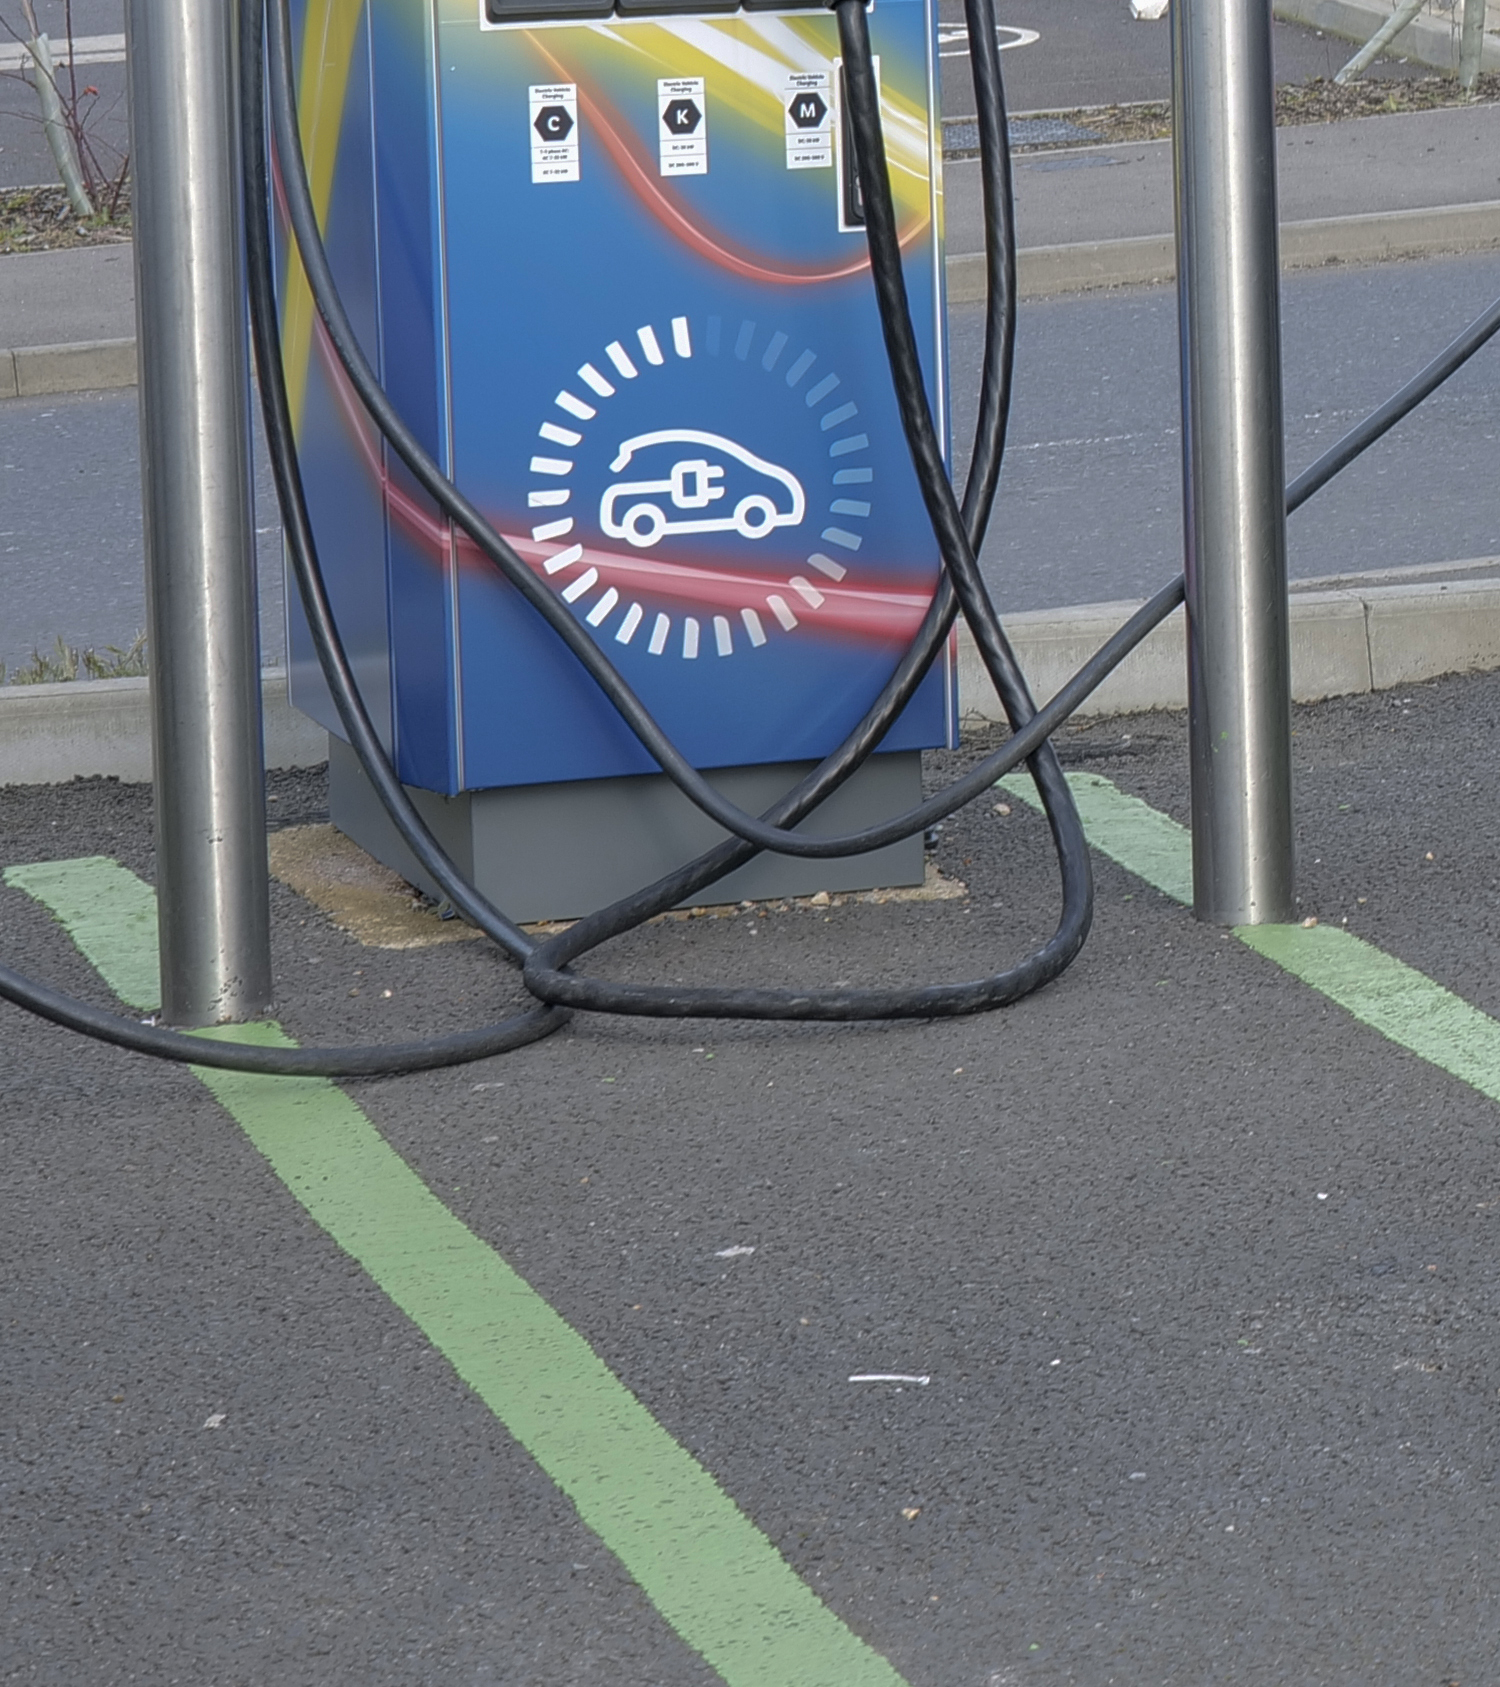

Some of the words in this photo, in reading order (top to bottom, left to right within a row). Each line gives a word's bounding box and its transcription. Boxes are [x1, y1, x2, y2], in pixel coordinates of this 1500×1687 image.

[677, 108, 689, 124] K
[800, 102, 816, 118] M
[548, 115, 560, 131] C
